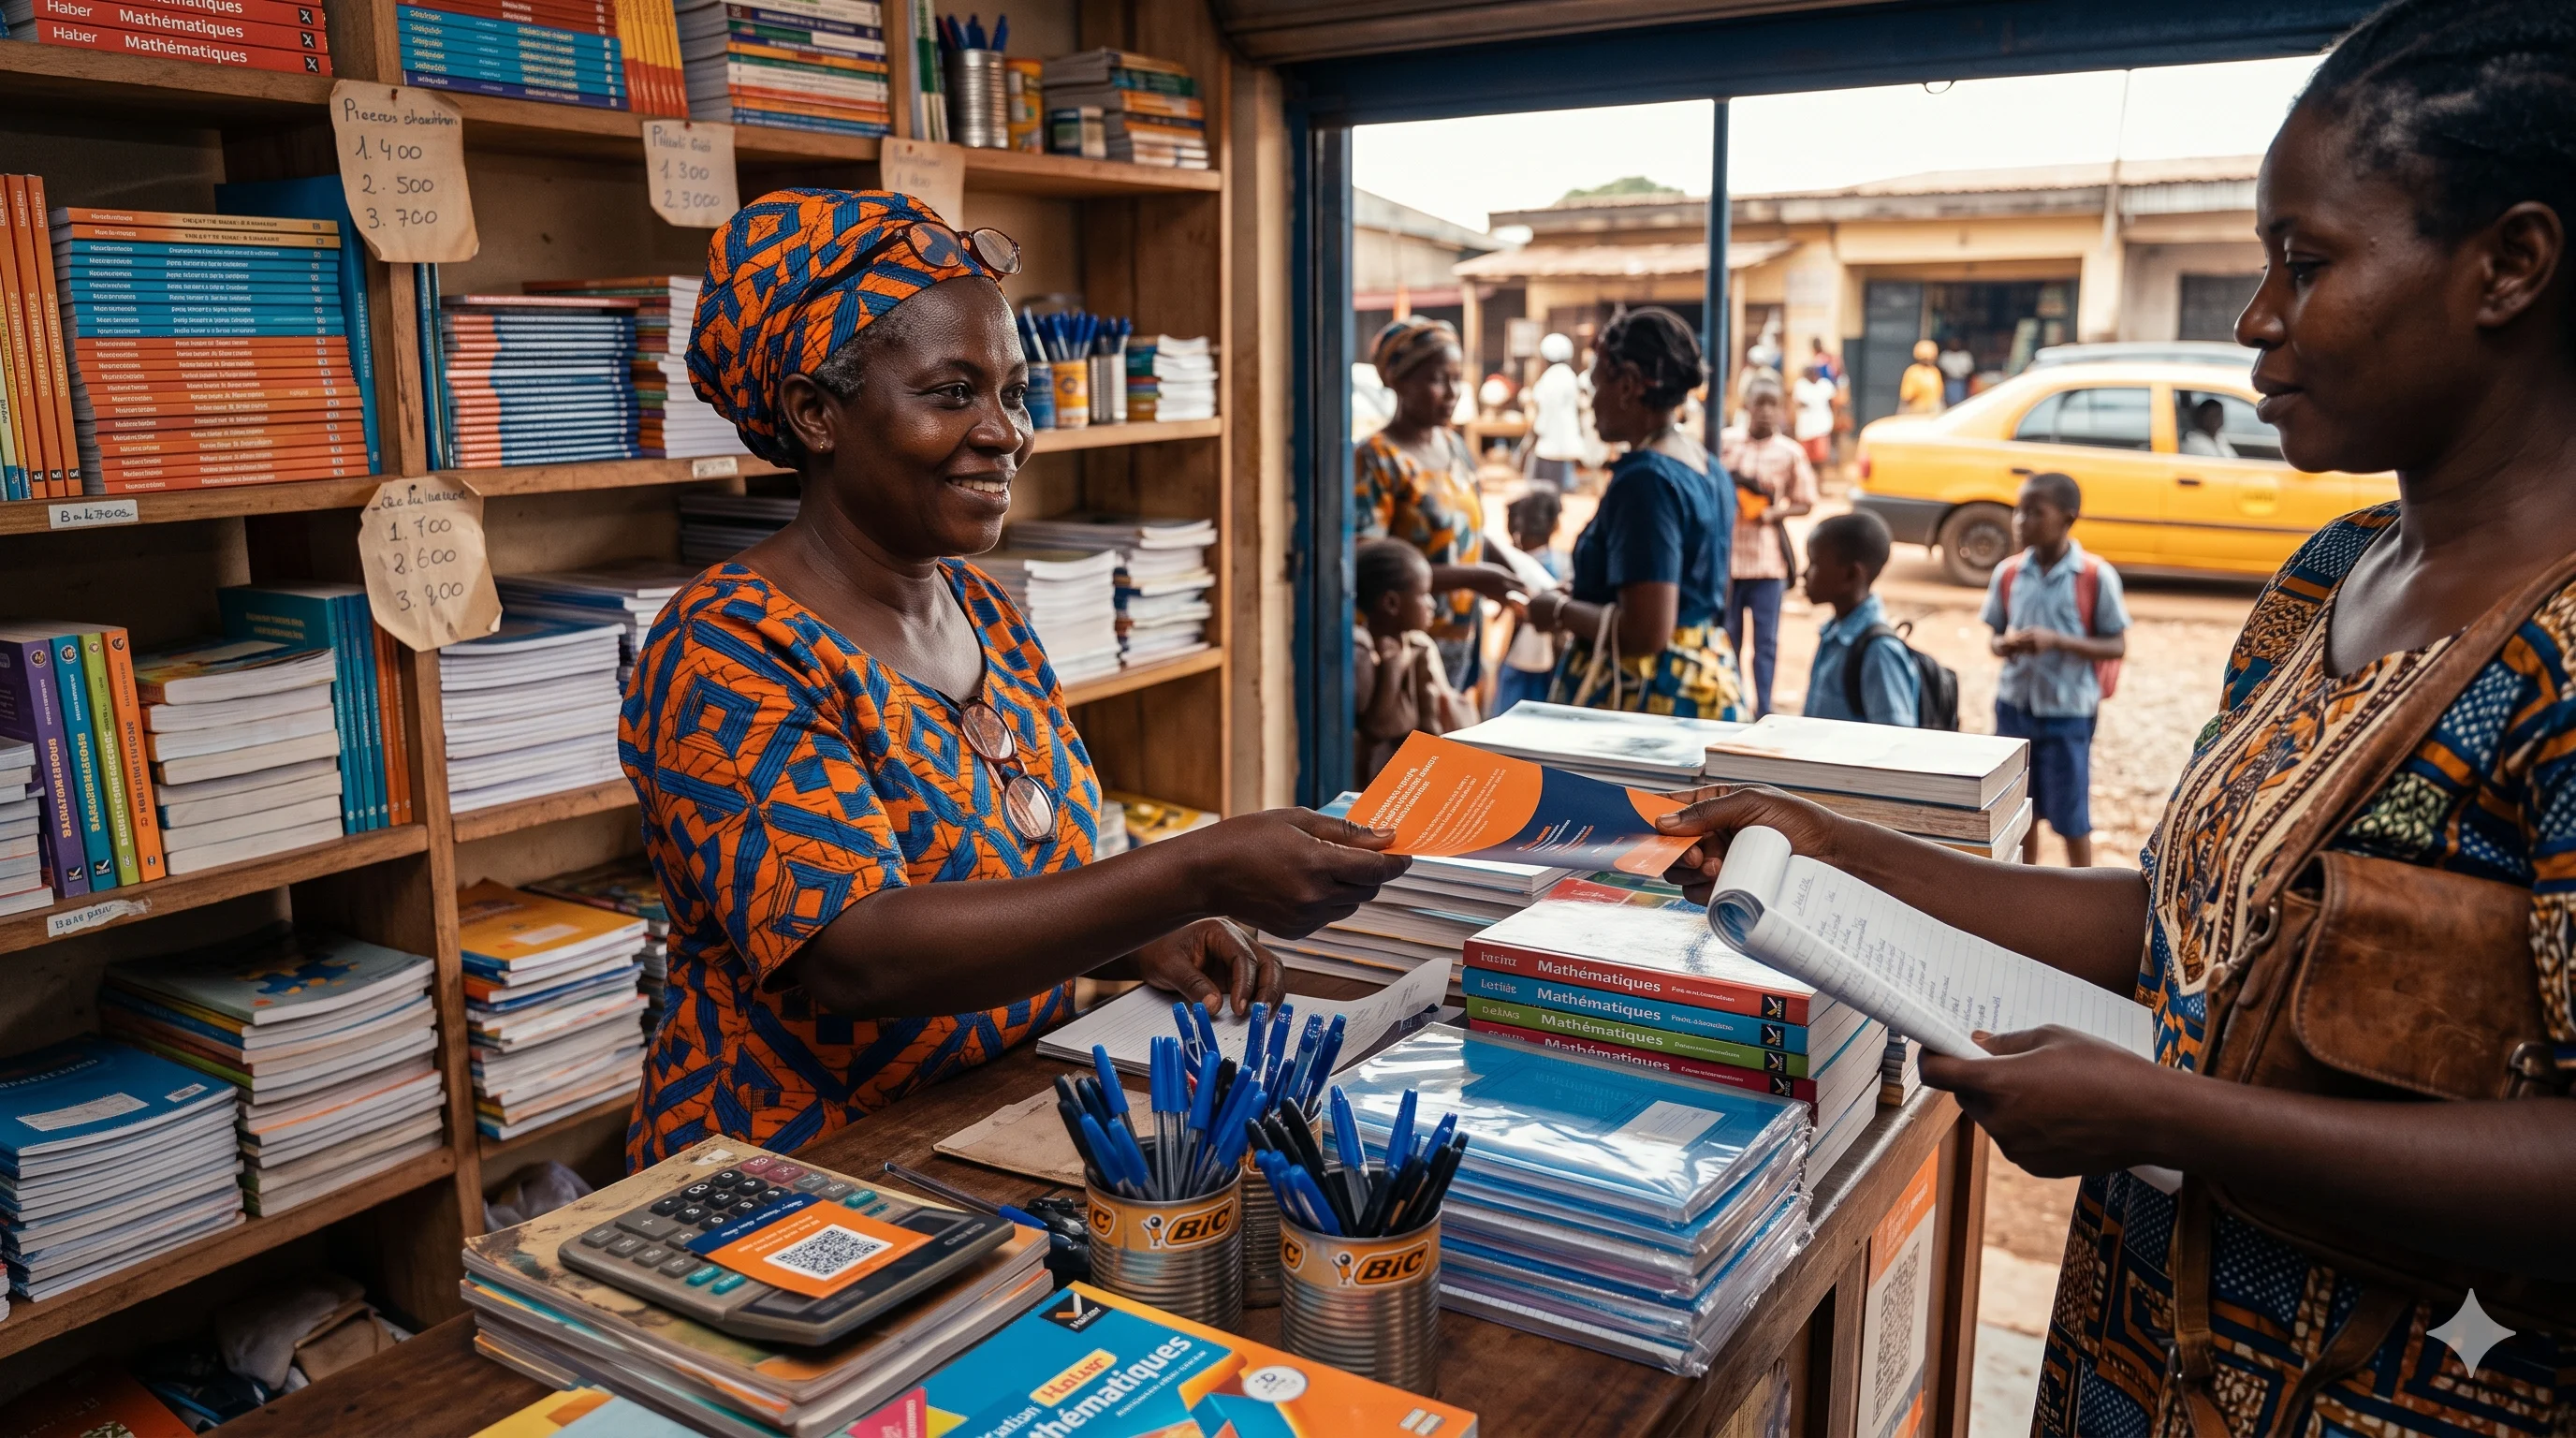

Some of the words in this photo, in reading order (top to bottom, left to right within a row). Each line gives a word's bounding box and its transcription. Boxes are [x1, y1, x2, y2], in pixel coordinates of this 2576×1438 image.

[119, 8, 243, 38] Mathématiques
[124, 35, 248, 63] Mathématiques
[380, 139, 422, 161] 400
[679, 161, 710, 180] 300
[396, 176, 434, 194] 500
[366, 207, 386, 228] 3.
[396, 209, 437, 227] 700
[389, 522, 408, 541] 1.
[414, 516, 452, 537] 700
[417, 548, 457, 569] 600
[396, 590, 417, 611] 3.
[1537, 960, 1661, 992] Mathématiques
[1537, 987, 1661, 1020] Mathématiques
[1541, 1014, 1663, 1046] Mathématiques
